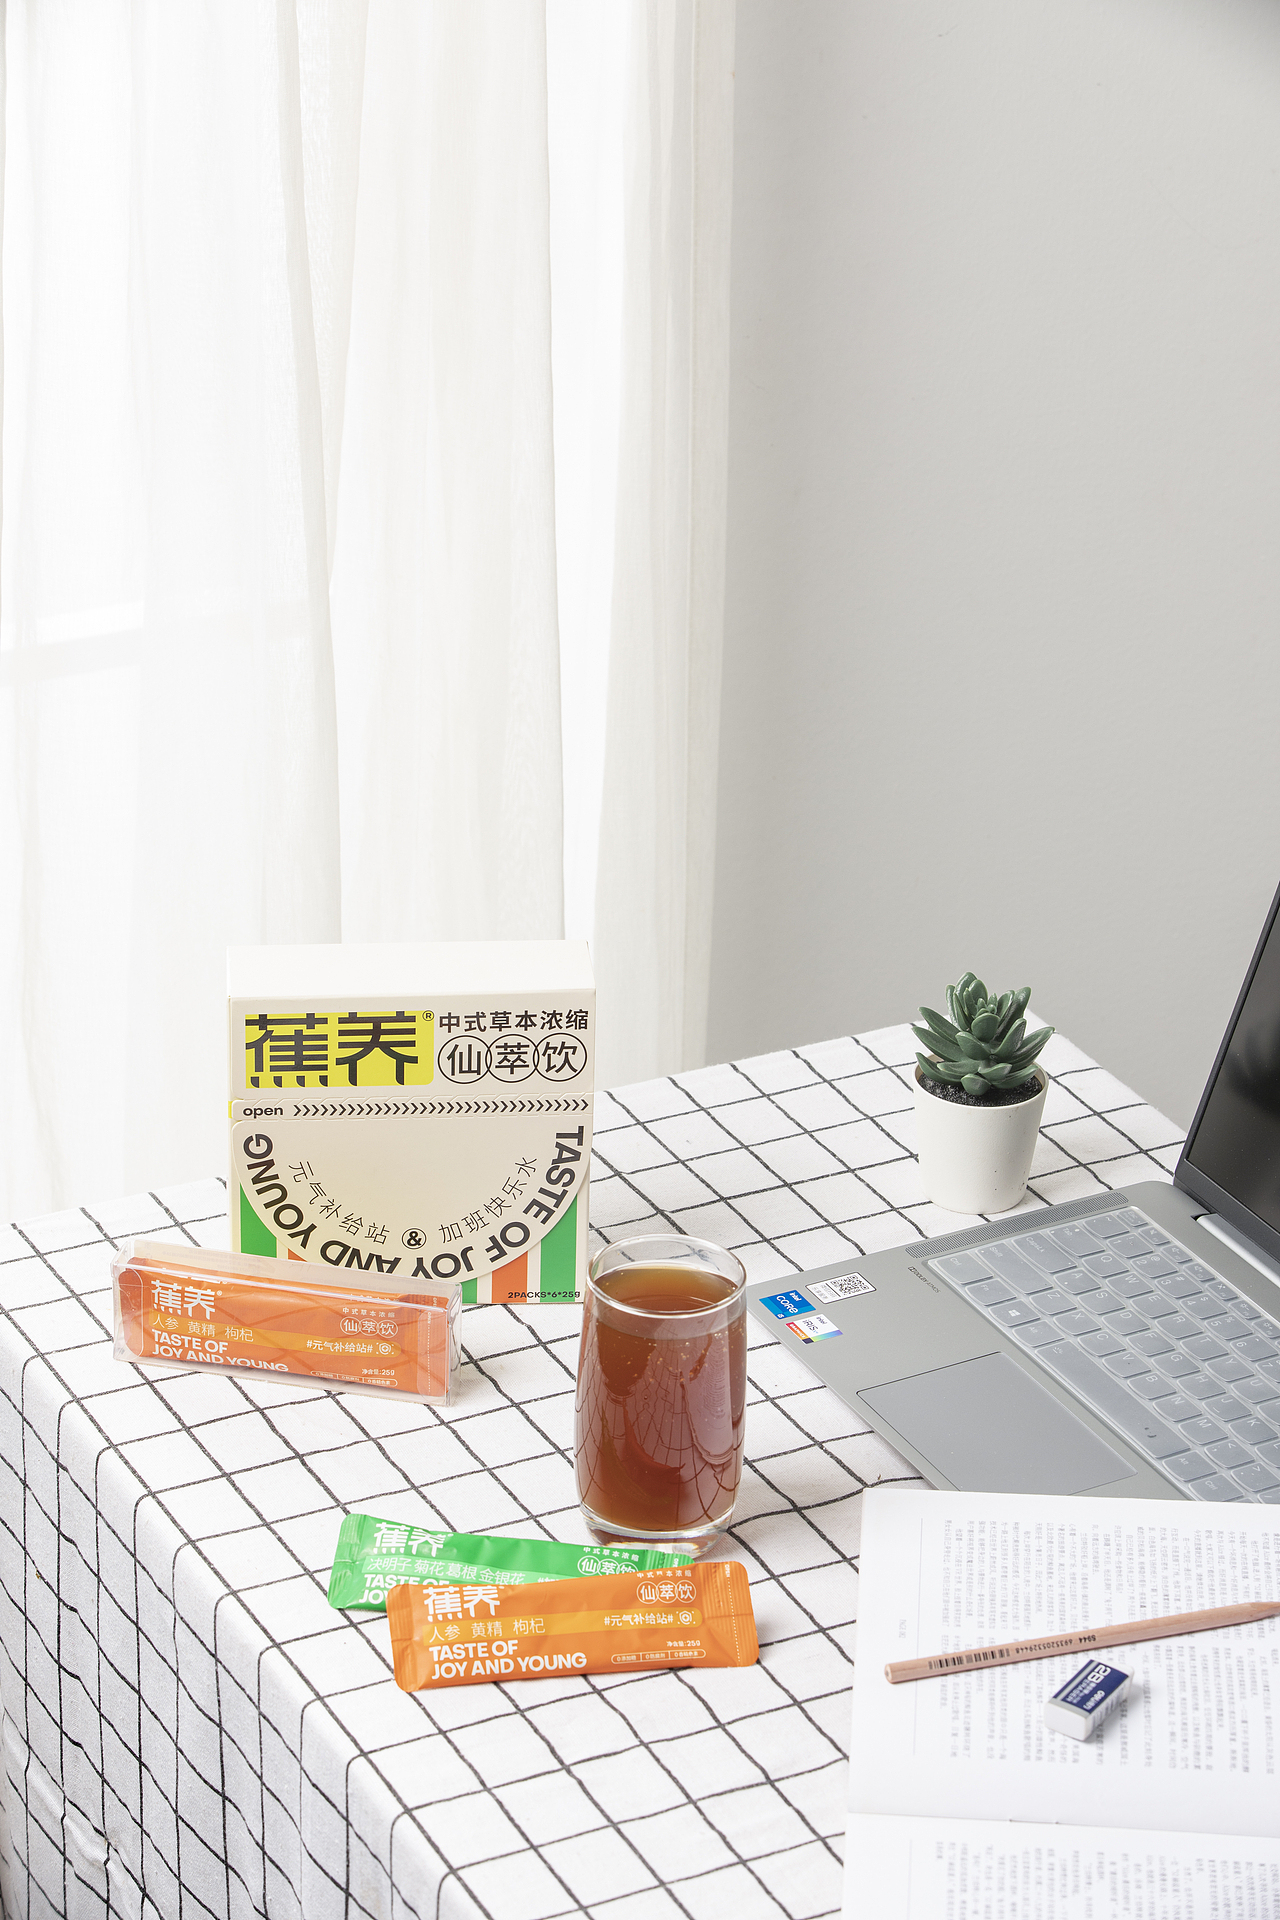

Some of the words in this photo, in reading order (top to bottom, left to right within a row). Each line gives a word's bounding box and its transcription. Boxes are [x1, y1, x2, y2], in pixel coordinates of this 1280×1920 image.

[439, 1009, 589, 1033] 中式草本浓缩
[245, 1010, 419, 1088] 蕉养
[444, 1037, 581, 1080] 仙萃饮
[243, 1105, 284, 1118] open
[522, 1125, 584, 1226] TASTE
[243, 1133, 318, 1250] YOUNG
[288, 1160, 390, 1245] 元气补给站
[438, 1156, 538, 1244] 加班快乐水
[486, 1221, 530, 1263] OF
[320, 1239, 402, 1276] AND
[411, 1245, 476, 1279] JOY
[151, 1280, 215, 1320] 蕉养
[342, 1307, 395, 1318] 中式草本浓缩
[152, 1329, 200, 1349] TASTE
[204, 1340, 229, 1354] OF
[153, 1314, 179, 1330] 人参
[187, 1321, 216, 1337] 黄精
[224, 1326, 254, 1342] 枸杞
[342, 1318, 396, 1337] 仙萃饮
[152, 1344, 183, 1359] JOY
[186, 1350, 223, 1364] AND
[226, 1356, 289, 1372] YOUNG
[306, 1339, 373, 1353] #元气补给站#
[373, 1522, 446, 1557] 蕉养
[583, 1546, 639, 1562] 中式草本浓缩
[364, 1574, 420, 1588] TASTE
[367, 1557, 412, 1572] 决明子
[414, 1559, 445, 1575] 菊花
[479, 1568, 526, 1586] 金银花
[637, 1569, 692, 1579] 中式草本浓缩
[423, 1585, 500, 1622] 蕉养
[638, 1580, 695, 1602] 仙萃饮
[429, 1624, 460, 1643] 人参
[471, 1621, 503, 1639] 黄精
[512, 1618, 546, 1635] 枸杞
[604, 1611, 674, 1627] #元气补给站#
[429, 1642, 489, 1662] TASTE
[491, 1640, 519, 1657] OF
[431, 1661, 467, 1680] JOY
[471, 1658, 514, 1676] AND
[518, 1652, 587, 1672] YOUNG
[1087, 1664, 1111, 1684] 2B
